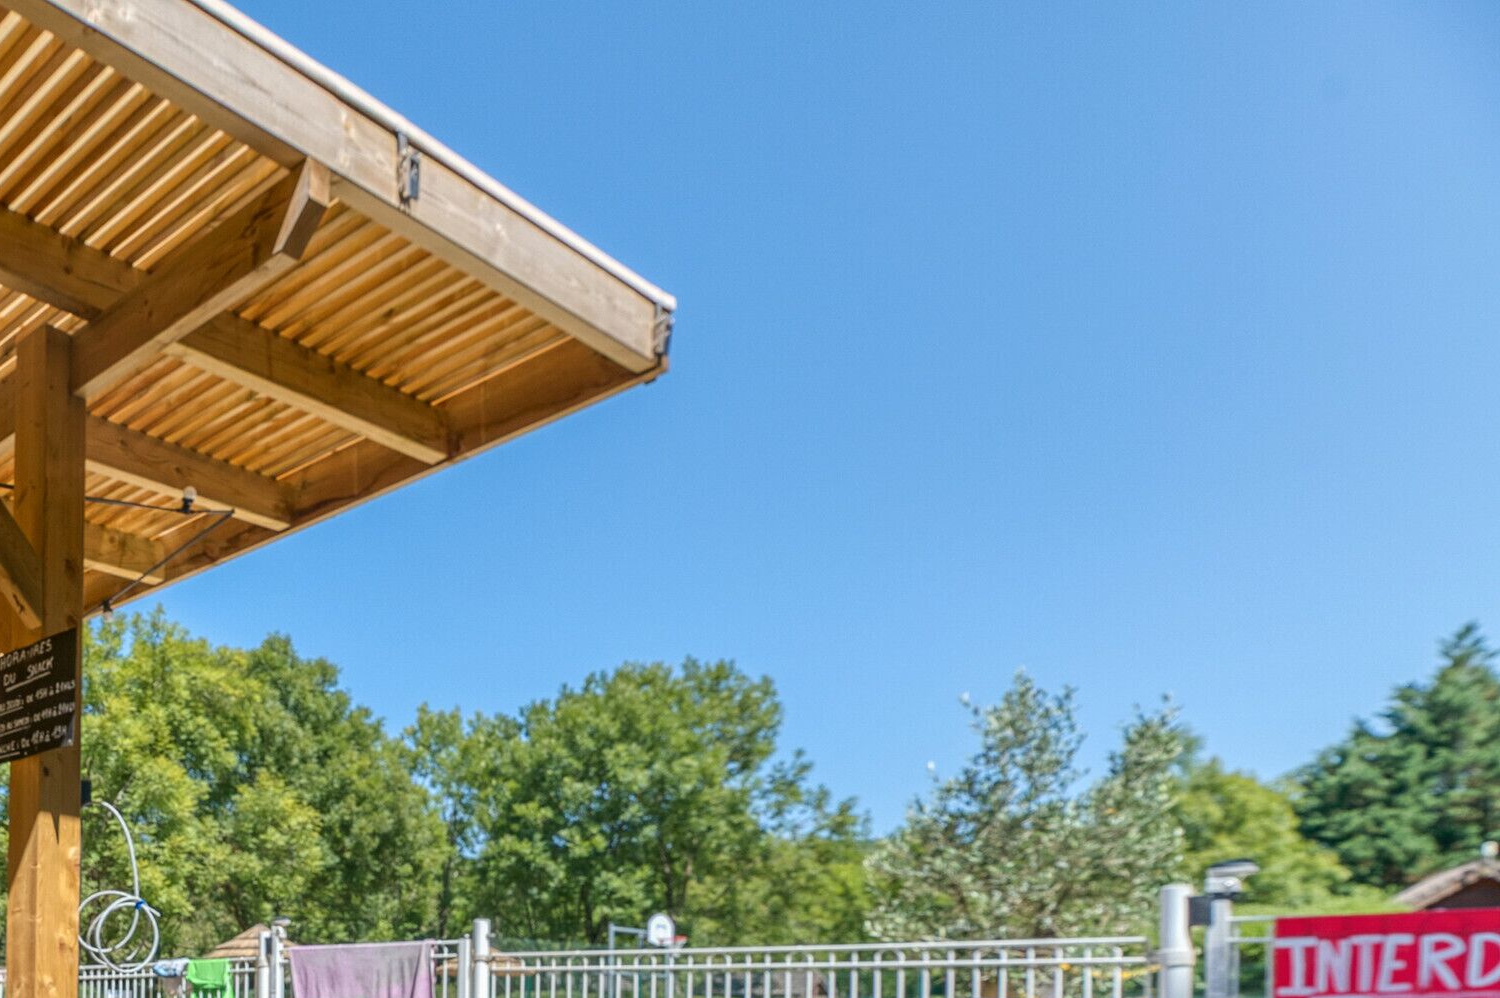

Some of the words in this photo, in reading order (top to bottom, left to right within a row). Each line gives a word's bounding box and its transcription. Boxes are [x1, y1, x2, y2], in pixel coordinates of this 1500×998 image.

[0, 638, 53, 671] HORAIRES
[3, 672, 16, 687] DU
[26, 656, 54, 679] SNACK
